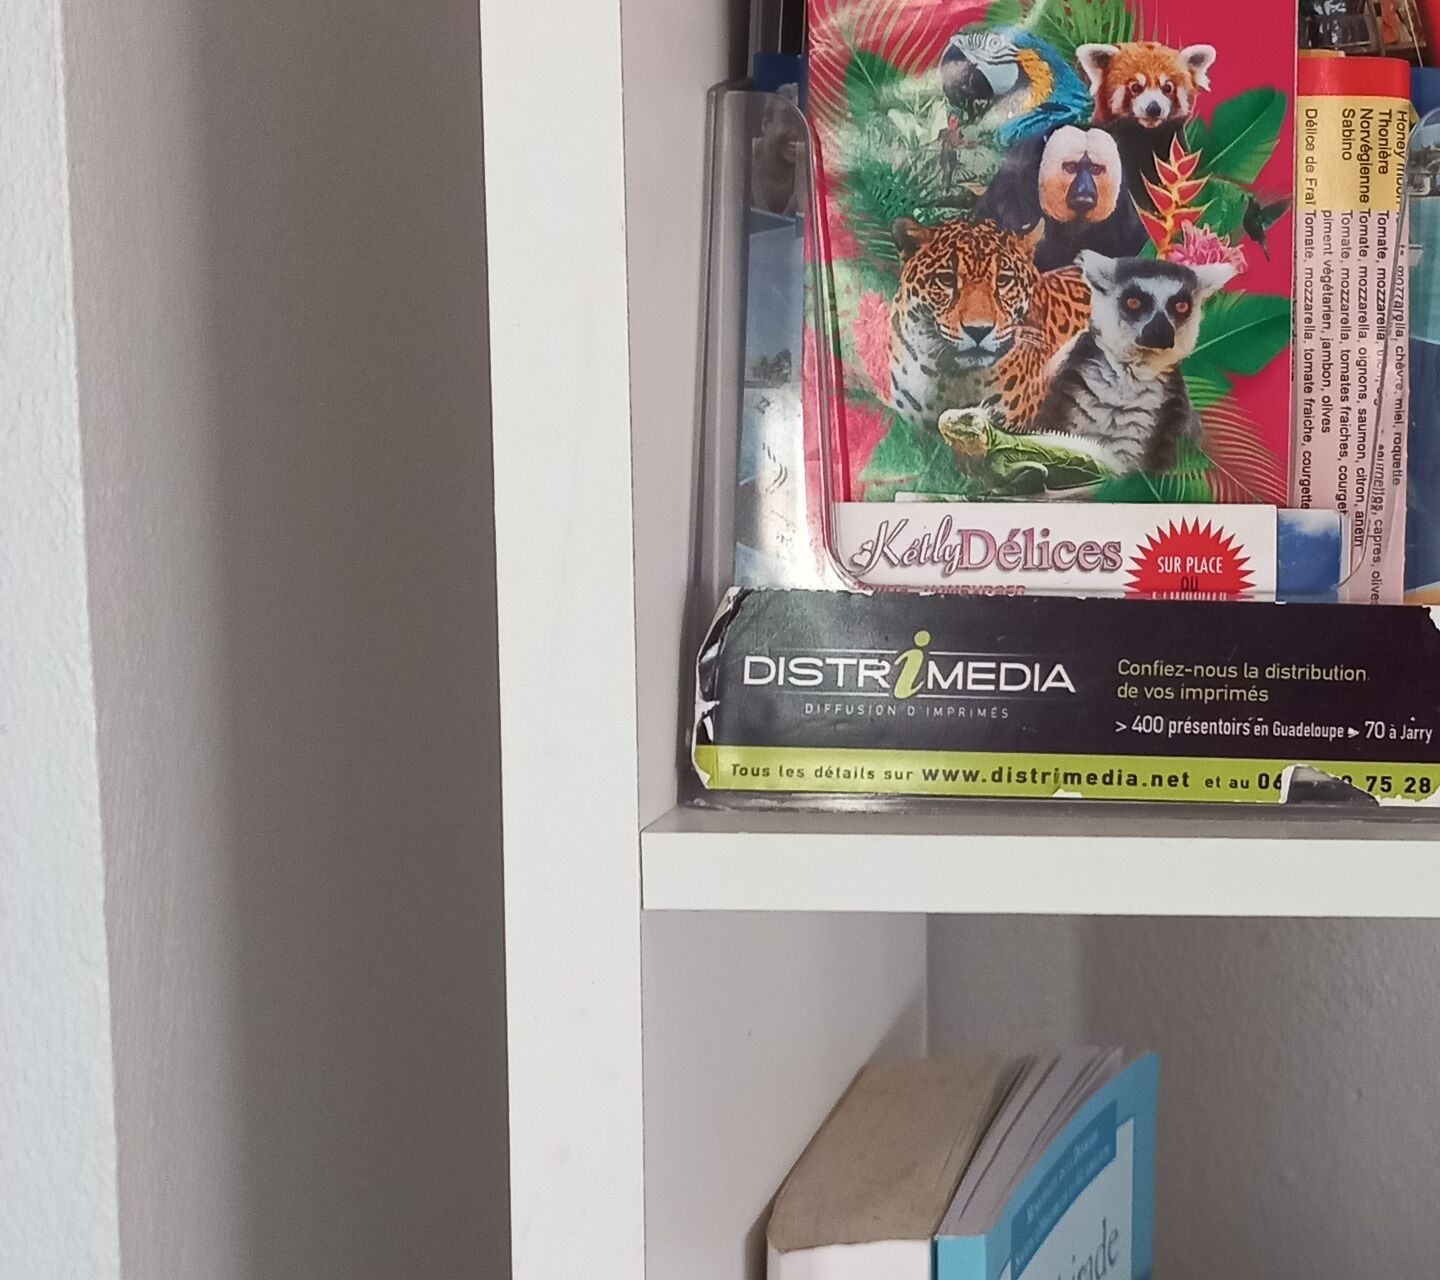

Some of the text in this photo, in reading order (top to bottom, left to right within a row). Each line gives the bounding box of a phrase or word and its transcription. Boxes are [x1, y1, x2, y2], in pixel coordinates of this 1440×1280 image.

[1305, 108, 1318, 151] Délice
[1341, 108, 1356, 161] Sabino
[1357, 108, 1373, 204] Norvégienne
[1378, 109, 1392, 175] Thonière
[1393, 110, 1408, 158] Honey
[1305, 156, 1318, 173] de
[1303, 210, 1317, 263] Tomate,
[1339, 210, 1354, 263] Tomate,
[1357, 208, 1372, 261] Tomate,
[1375, 210, 1390, 263] Tomate,
[1303, 267, 1316, 344] mozzarella,
[1320, 210, 1335, 433] piment végétarien, jambon, olives
[1339, 268, 1352, 344] mozzarella,
[1357, 266, 1370, 343] mozzarella,
[1303, 348, 1315, 394] tomate
[1340, 349, 1352, 402] tomates
[1355, 347, 1368, 404] oignons,
[1301, 398, 1316, 446] fraiche,
[1337, 406, 1352, 461] fraiches,
[1355, 408, 1367, 463] saumon,
[1391, 432, 1403, 485] roquette
[1353, 467, 1366, 507] citron,
[1158, 556, 1223, 574] SUR PLACE
[1117, 659, 1367, 682] Confiez-nous la distribution
[1117, 683, 1269, 705] de vos imprimés
[805, 702, 1010, 719] DIFFUSION D'IMPRIMÉS
[1131, 716, 1433, 744] 400 présentoirs en Guadeloupe 70 à Jarry
[731, 764, 770, 778] Tous
[779, 764, 805, 779] les
[813, 764, 876, 781] détails
[884, 768, 914, 781] sur
[922, 765, 1190, 789] www.distrimedia.net
[1204, 776, 1222, 789] et
[1229, 778, 1250, 790] au
[1365, 775, 1392, 793] 75
[1404, 776, 1431, 794] 28
